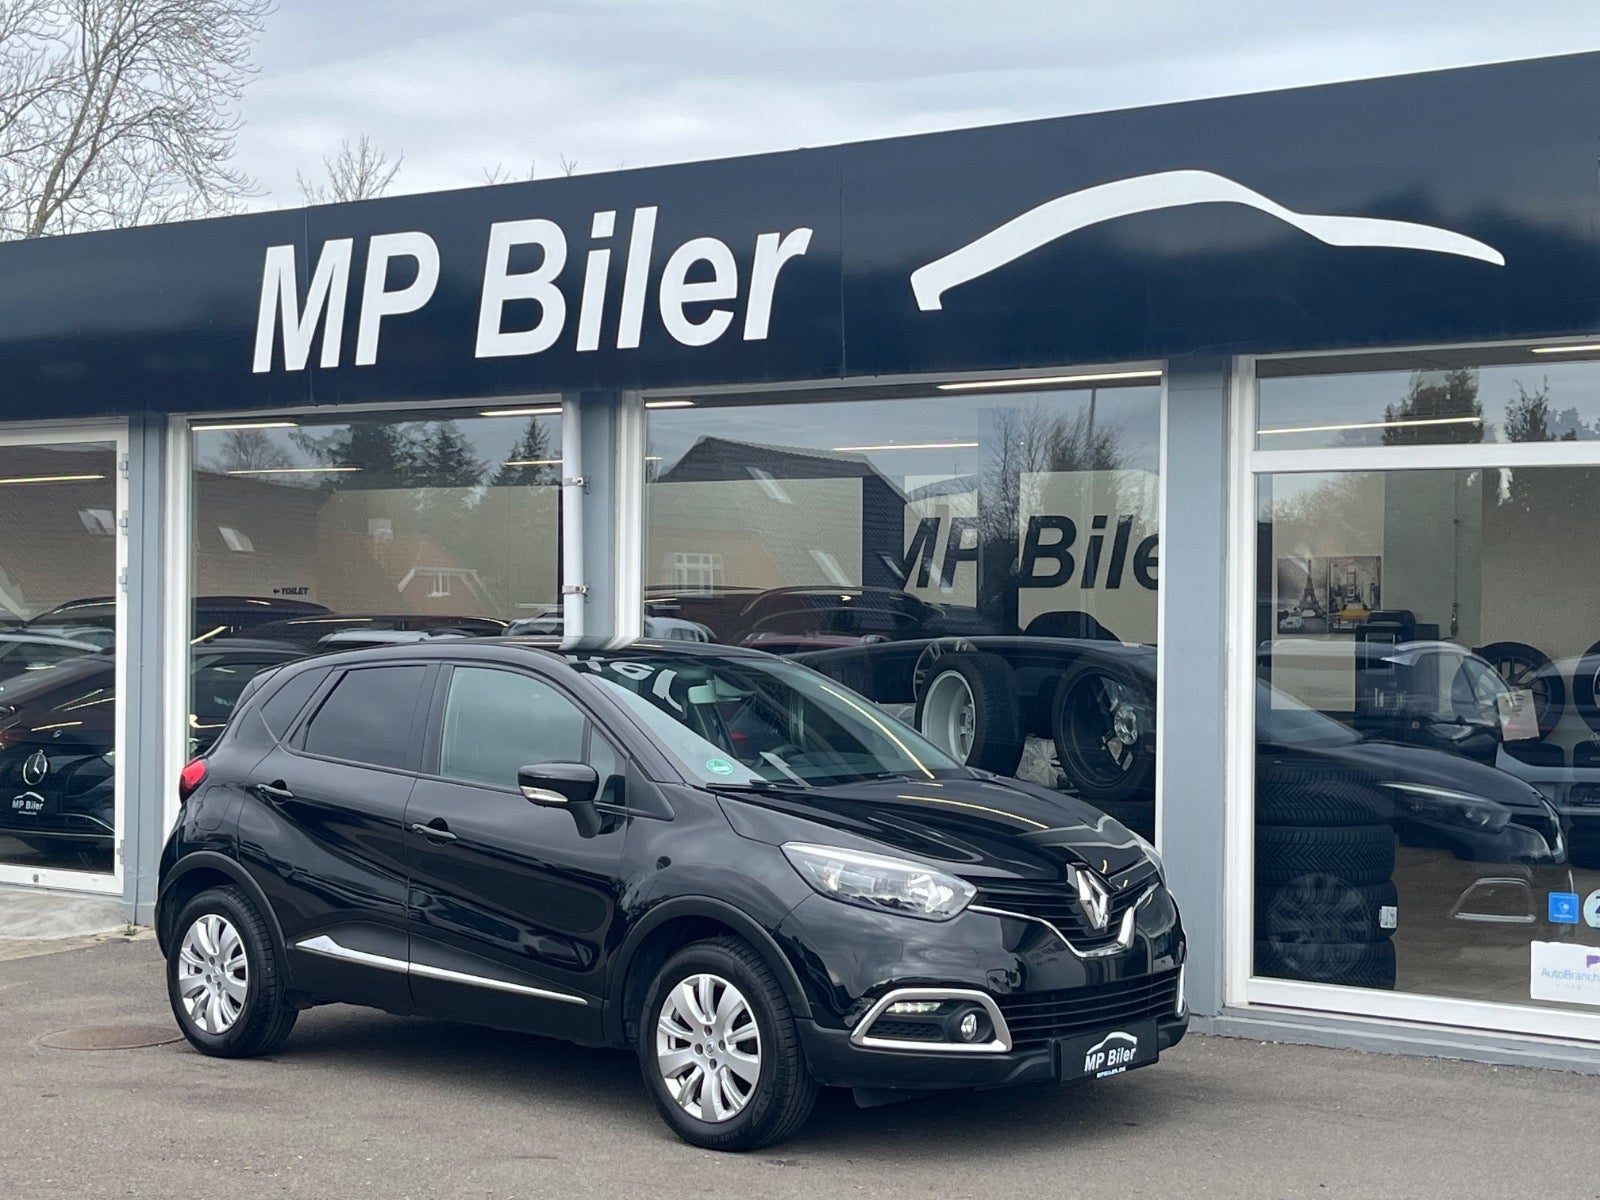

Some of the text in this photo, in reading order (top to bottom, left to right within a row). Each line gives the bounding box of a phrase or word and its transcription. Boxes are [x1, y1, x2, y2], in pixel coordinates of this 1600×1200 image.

[252, 206, 813, 373] MP Biler
[281, 587, 309, 595] TOILET
[12, 800, 44, 810] MP Biler
[1084, 1047, 1137, 1072] MP Biler
